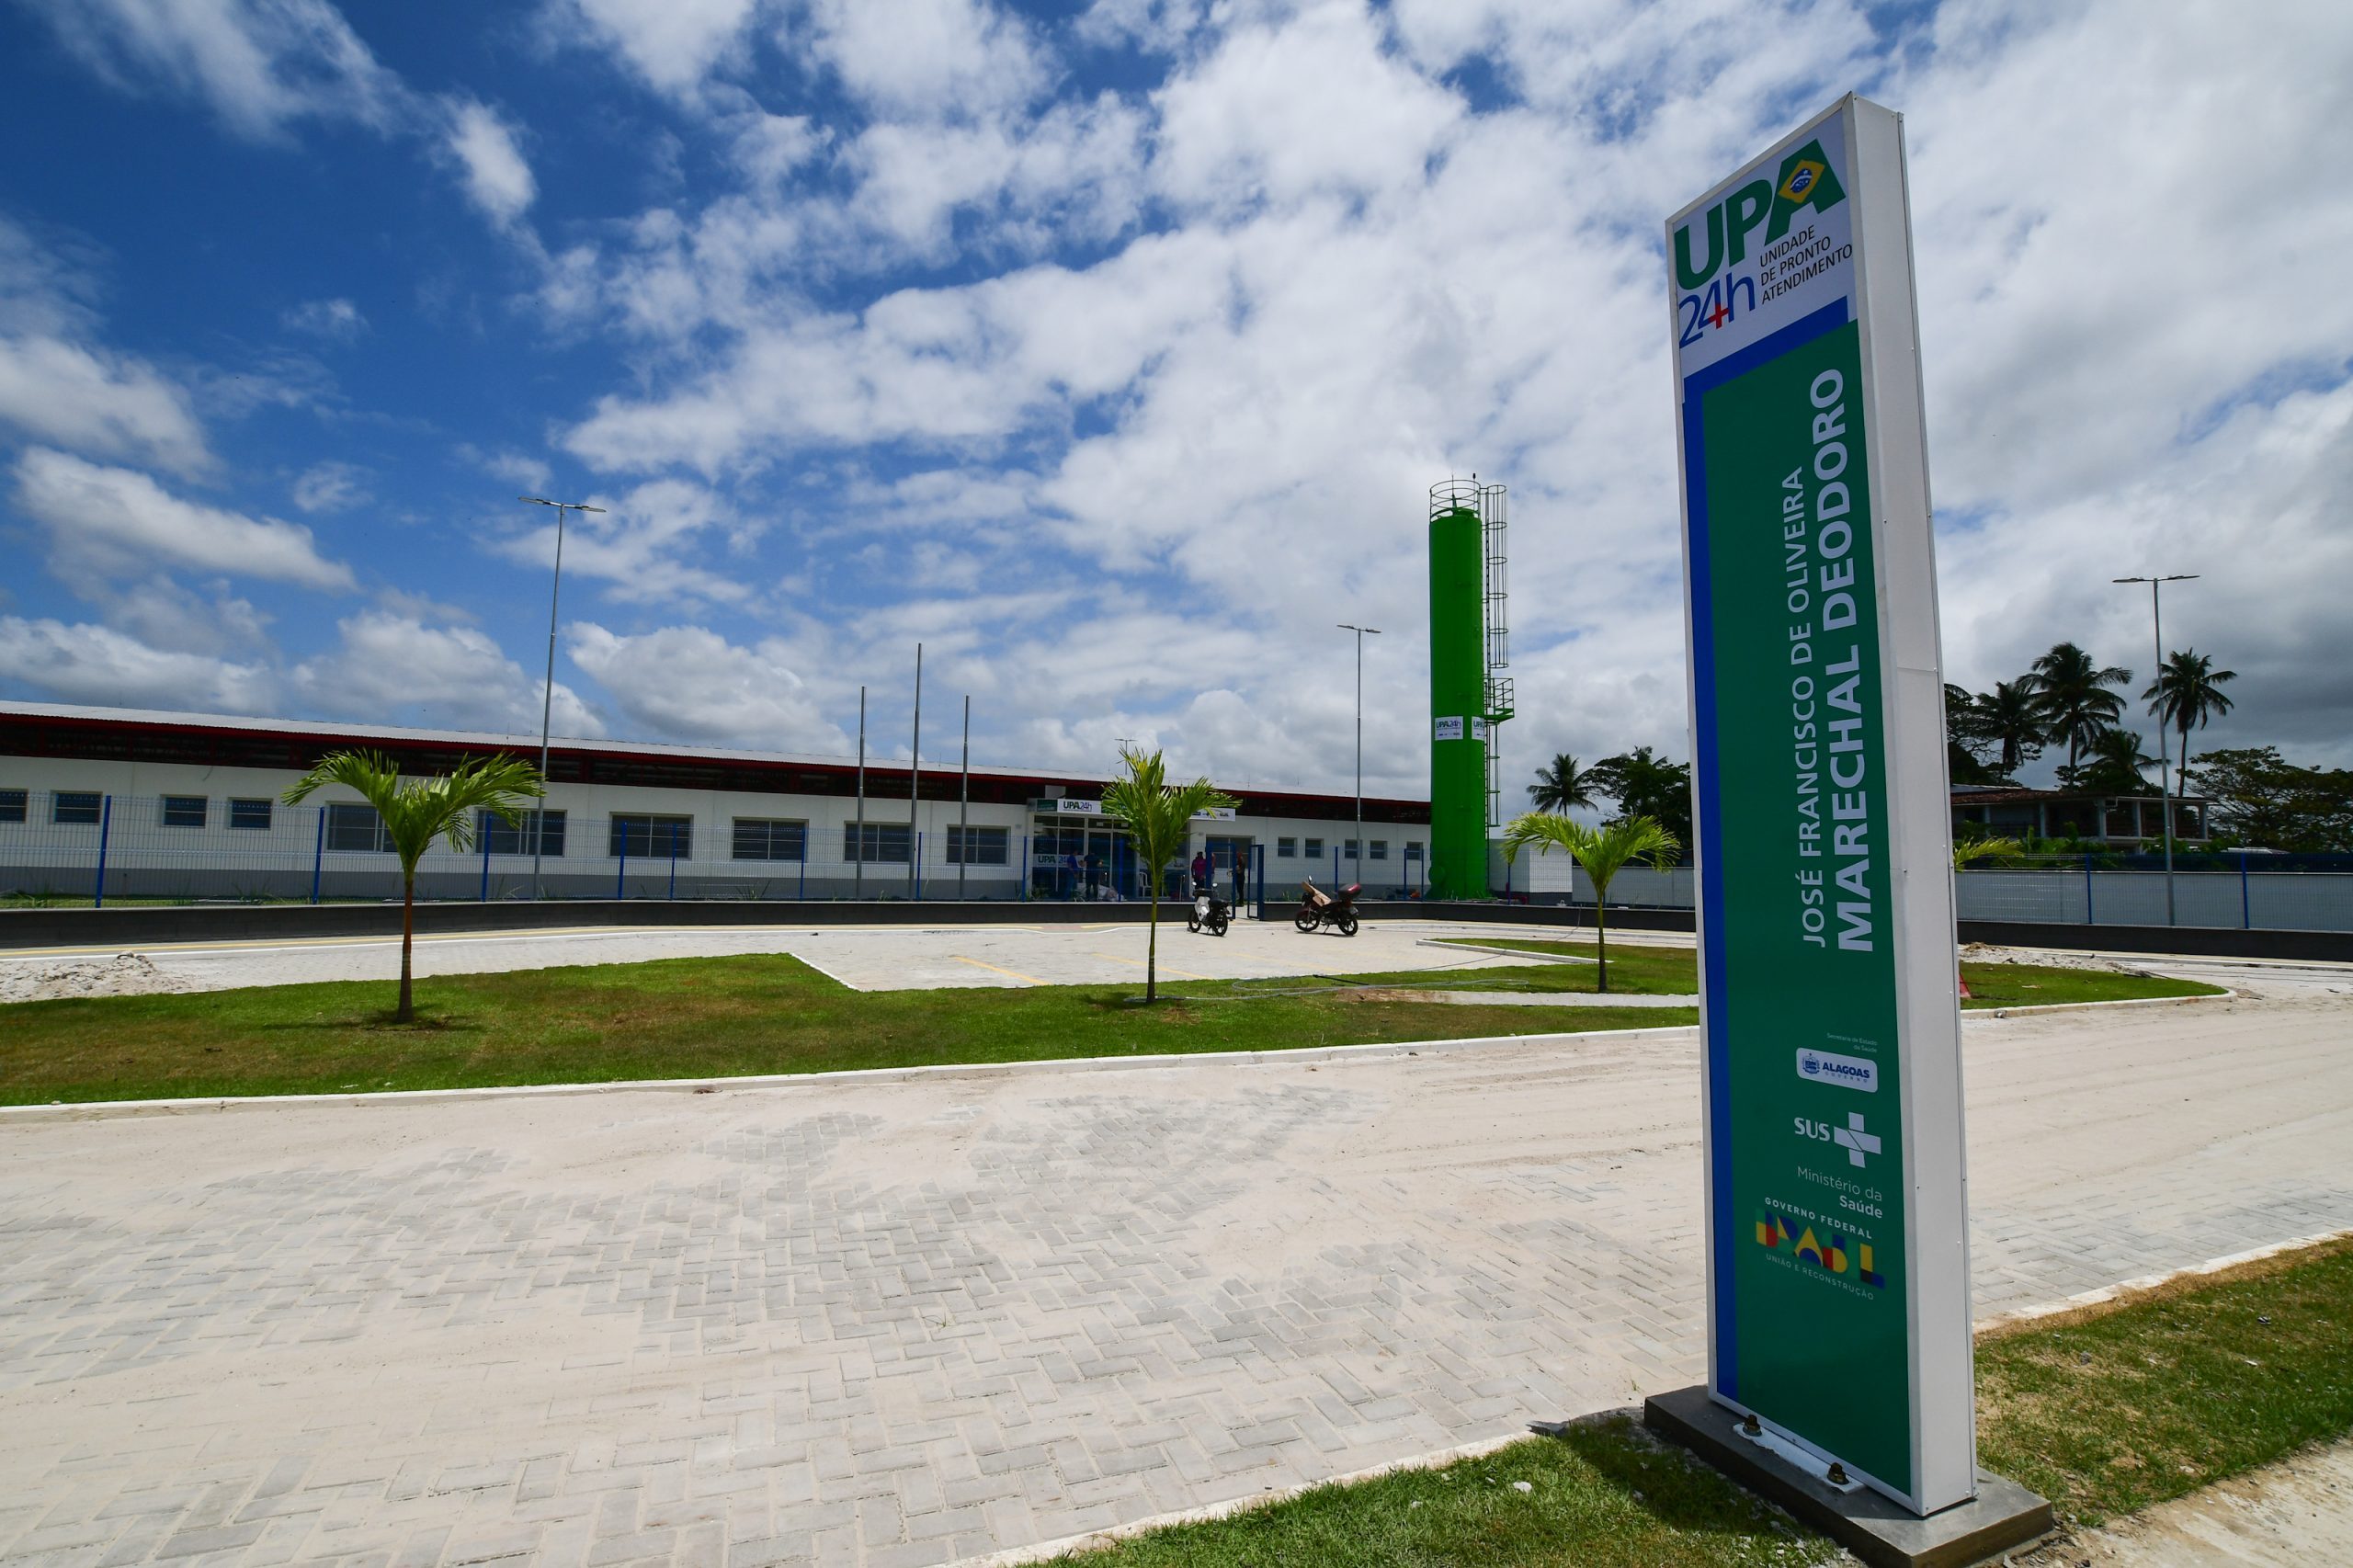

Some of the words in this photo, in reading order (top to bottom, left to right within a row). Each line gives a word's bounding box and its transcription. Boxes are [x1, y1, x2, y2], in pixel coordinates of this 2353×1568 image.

[1674, 138, 1847, 290] UPA
[1760, 224, 1815, 267] UNIDADE
[1761, 271, 1777, 286] DE
[1779, 235, 1831, 278] PRONTO
[1761, 244, 1853, 305] ATENDIMENTO
[1678, 272, 1756, 349] 24h
[1810, 369, 1857, 631] DEODORO
[1782, 466, 1810, 613] OLIVEIRA
[1790, 622, 1813, 665] DE
[1792, 676, 1822, 857] FRANCISCO
[1825, 644, 1872, 951] MARECHAL
[1795, 869, 1825, 948] JOSÉ
[1822, 1062, 1870, 1079] ALAGOAS
[1825, 1072, 1868, 1083] GOVERNO
[1793, 1116, 1831, 1142] SUS
[1797, 1165, 1861, 1196] Ministério
[1865, 1182, 1882, 1202] da
[1839, 1195, 1883, 1219] Saúde
[1765, 1197, 1816, 1221] GOVERNO
[1820, 1214, 1872, 1240] FEDERAL
[1766, 1253, 1791, 1268] UNIÃO
[1802, 1267, 1874, 1301] RECONSTRUÇÃO
